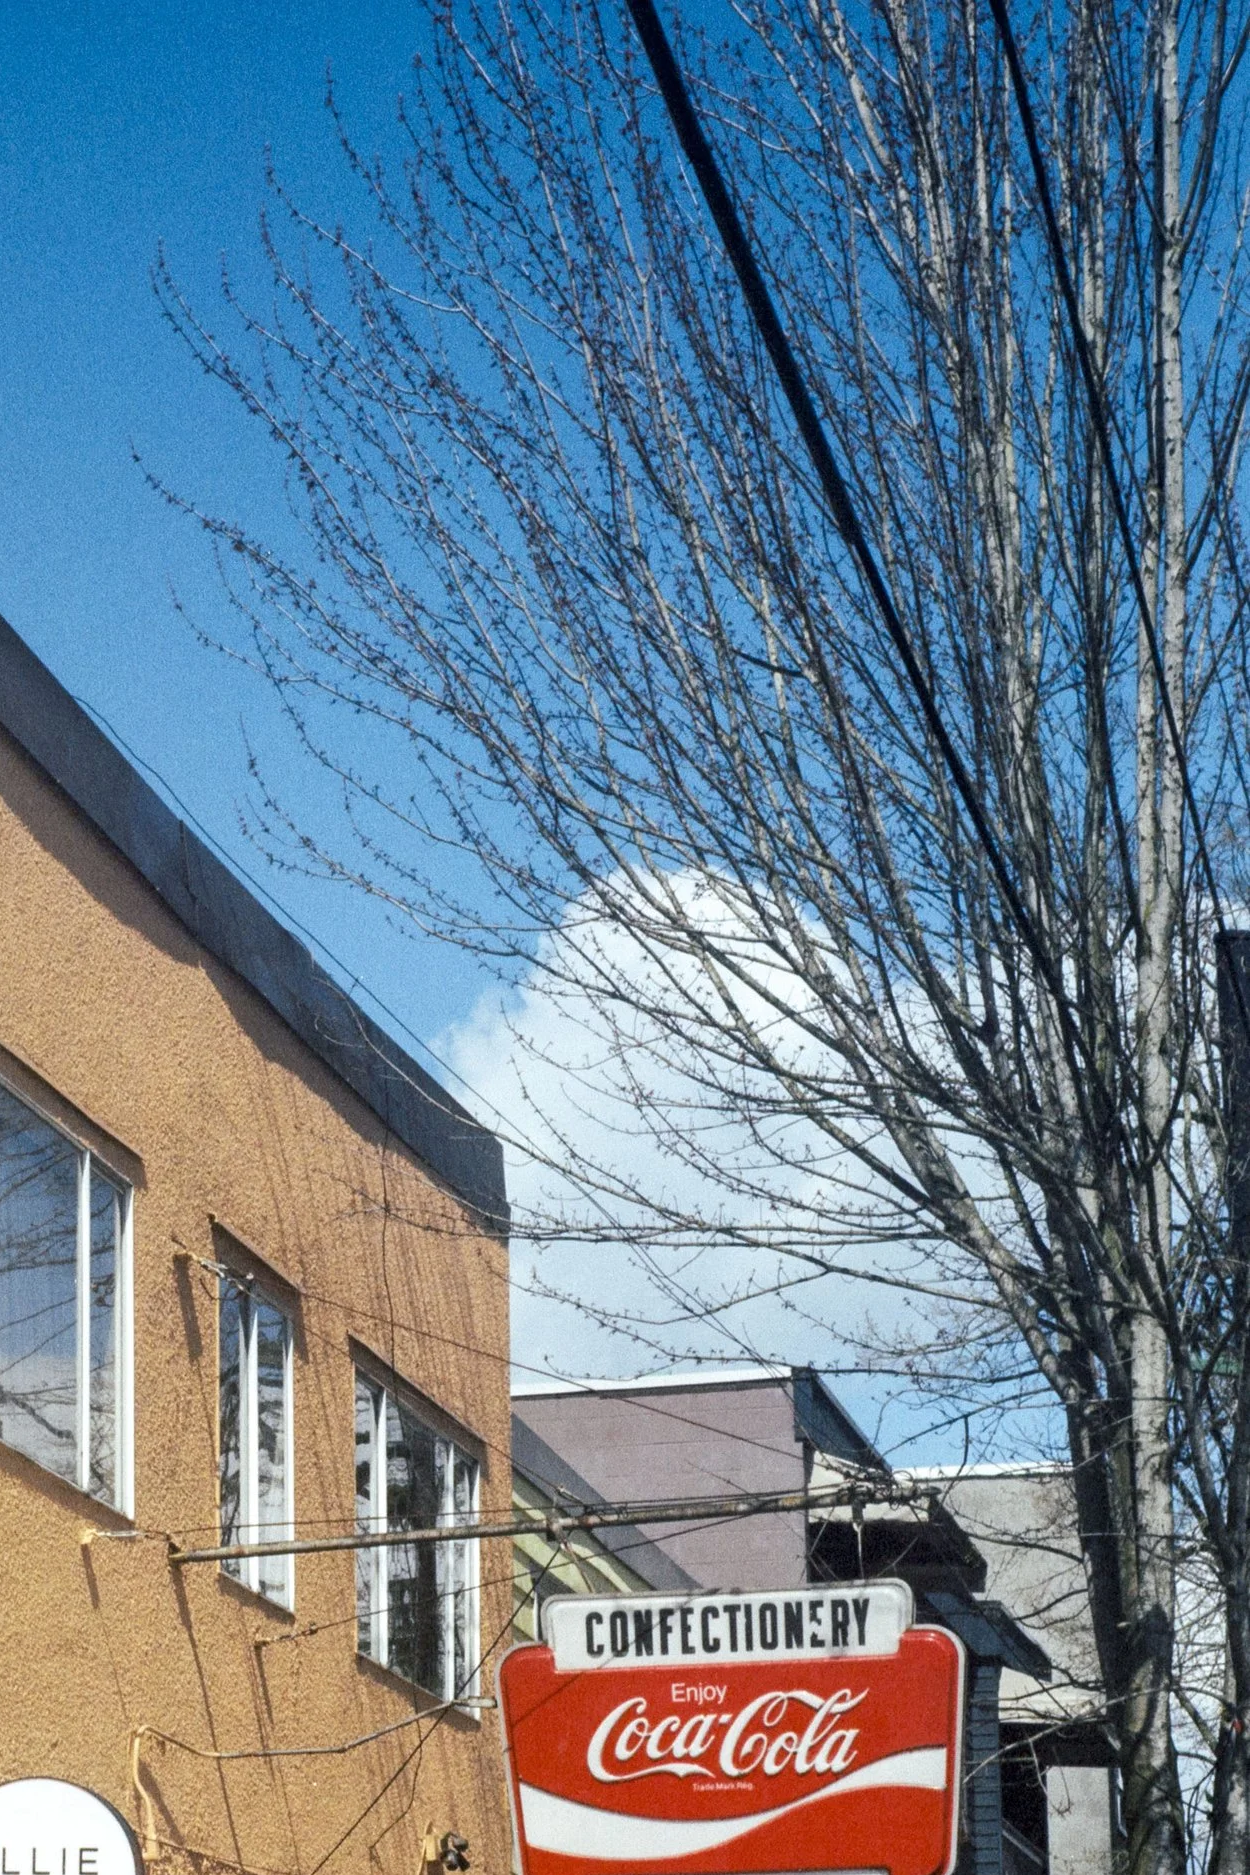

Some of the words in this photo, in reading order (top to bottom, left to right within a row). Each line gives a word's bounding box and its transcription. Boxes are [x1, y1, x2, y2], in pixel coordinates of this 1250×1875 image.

[585, 1598, 871, 1658] CONFECTIONERY
[671, 1683, 728, 1704] Enjoy
[586, 1688, 870, 1783] Coca-Cola
[692, 1783, 714, 1792] Trade
[716, 1782, 735, 1790] Mark
